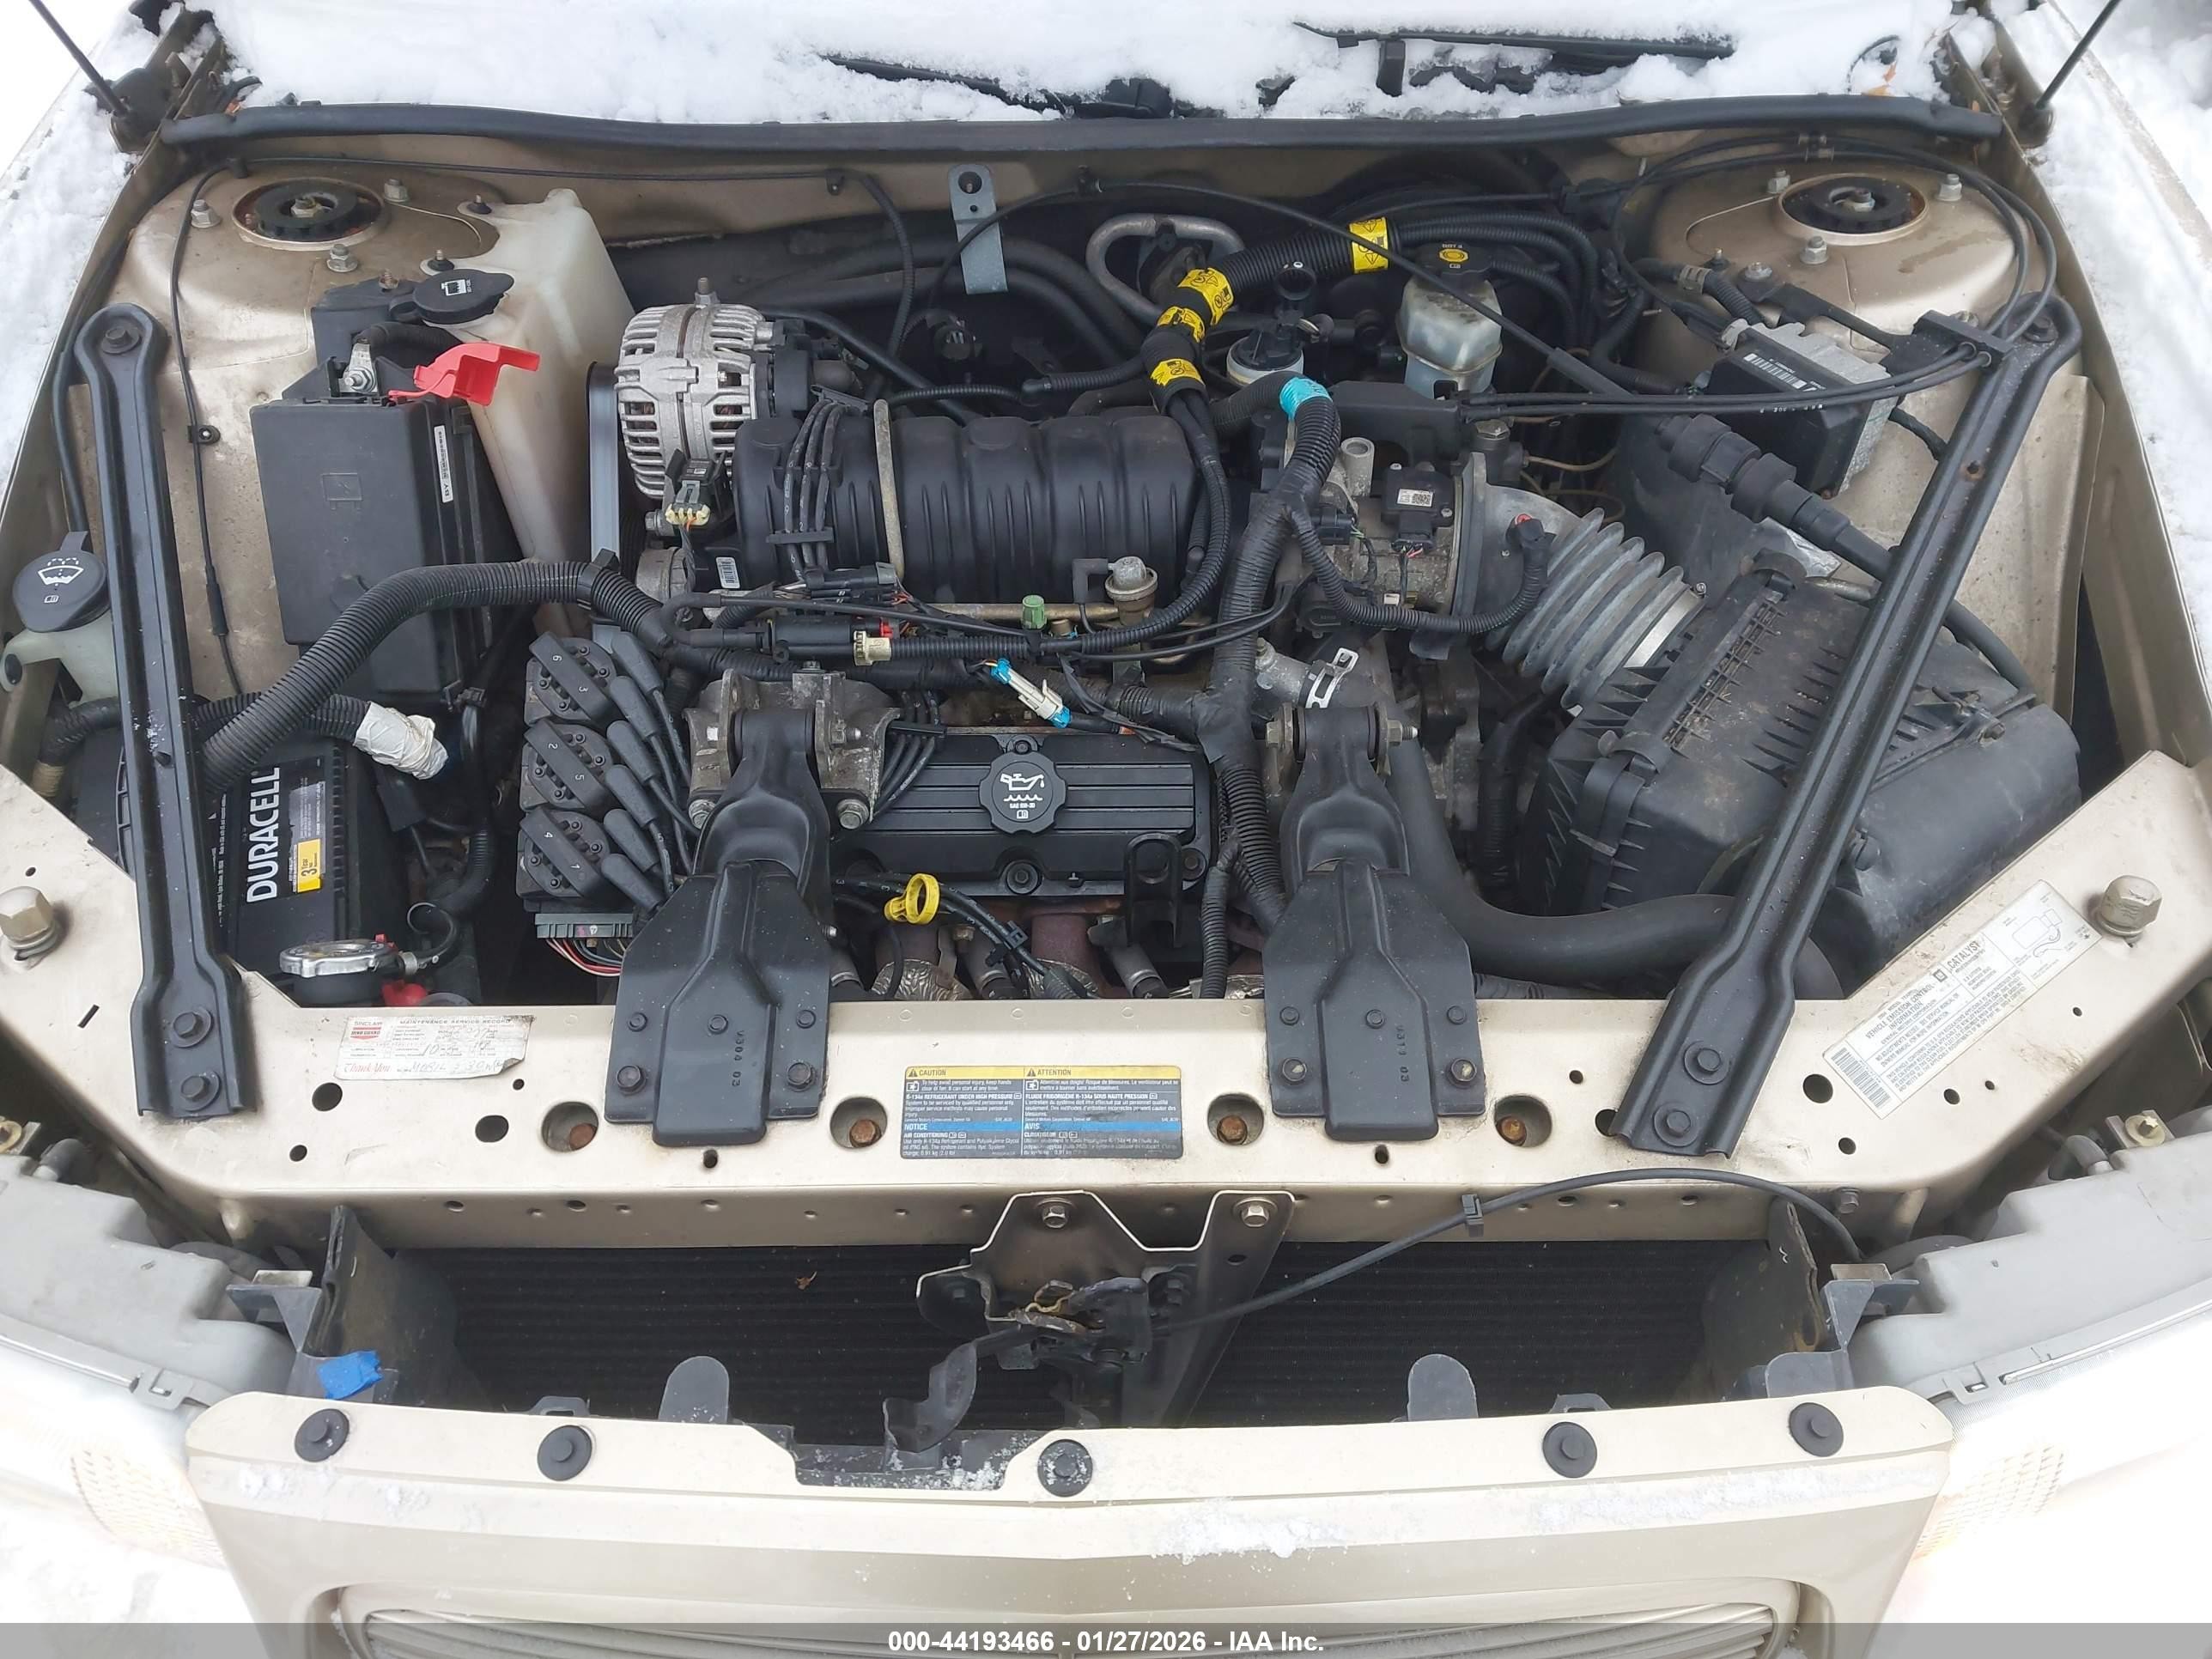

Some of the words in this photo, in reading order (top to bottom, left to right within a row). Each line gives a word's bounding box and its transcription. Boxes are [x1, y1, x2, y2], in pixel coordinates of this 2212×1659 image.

[246, 767, 282, 903] DURACELL
[301, 867, 317, 877] 3
[1946, 939, 1981, 969] CATALYST
[1865, 1020, 1887, 1040] VEHICLE
[1886, 1000, 1911, 1023] EMISSION
[1910, 982, 1934, 1004] CONTROL
[1887, 1000, 1923, 1030] INFORMATION
[344, 1062, 371, 1072] Thank
